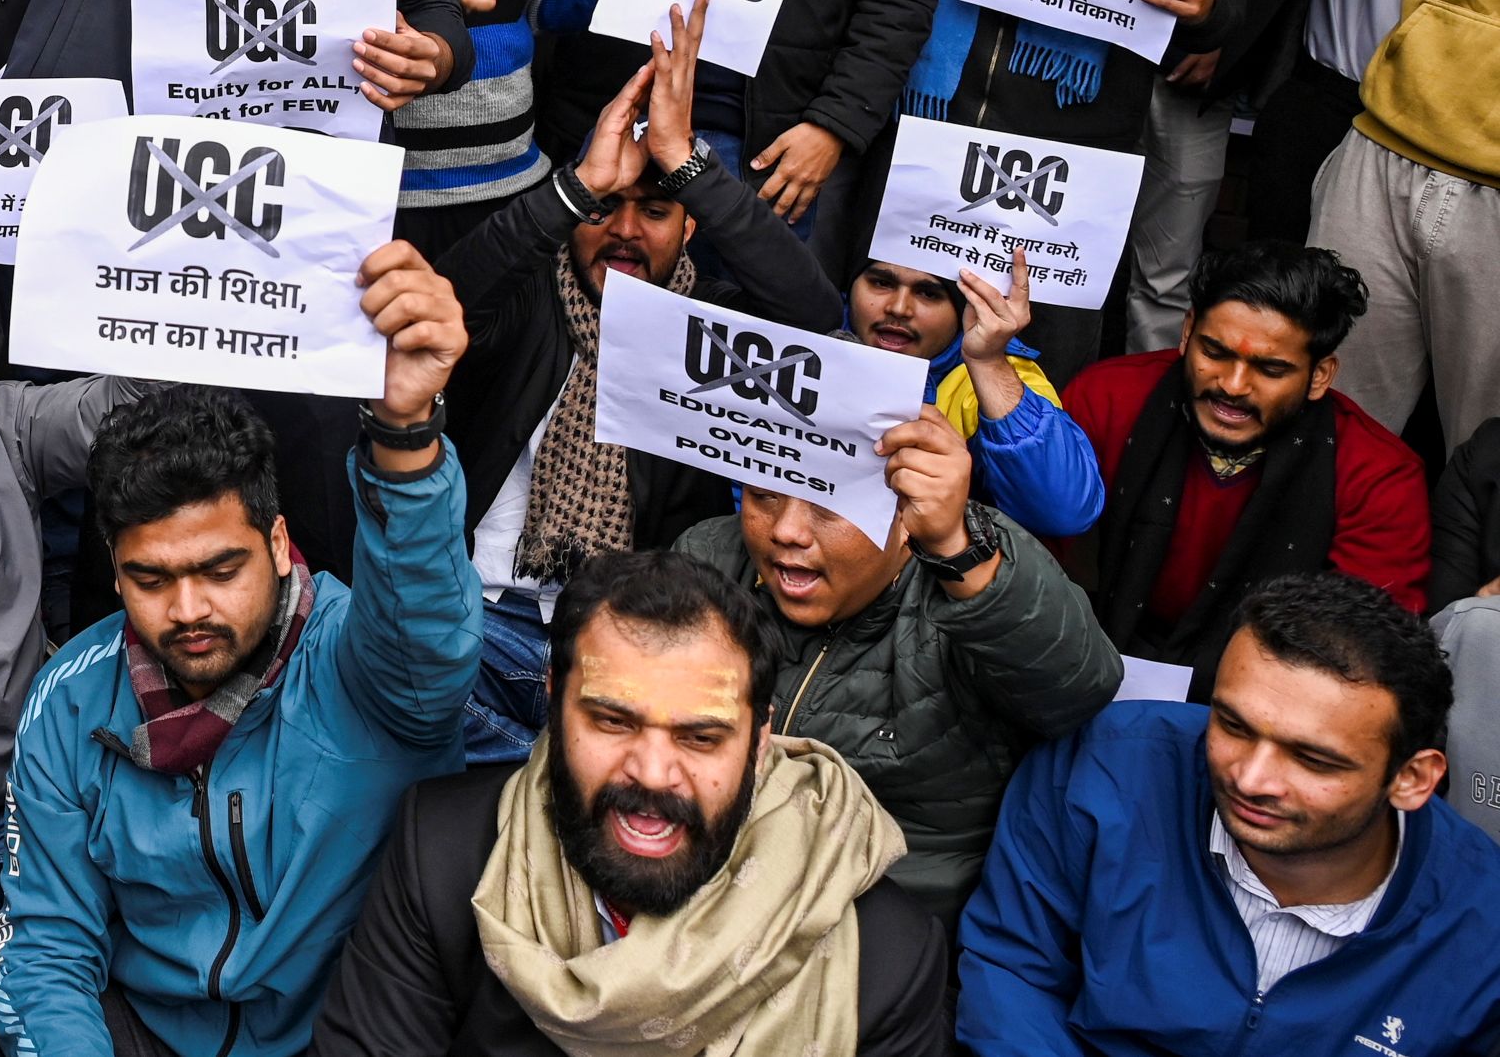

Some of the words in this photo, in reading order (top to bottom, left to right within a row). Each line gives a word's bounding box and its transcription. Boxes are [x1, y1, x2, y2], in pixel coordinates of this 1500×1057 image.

[168, 82, 249, 103] Equity
[257, 79, 294, 92] for
[302, 76, 361, 95] ALL,
[239, 102, 274, 118] for
[283, 99, 340, 114] FEW
[1, 194, 16, 212] में
[126, 136, 286, 242] UGC
[960, 141, 1069, 216] UGC
[910, 235, 962, 258] भविष्य
[966, 247, 981, 264] से
[1052, 269, 1087, 287] नहीं!
[930, 214, 982, 239] नियमों
[984, 226, 999, 244] में
[1046, 241, 1080, 261] करो,
[95, 264, 162, 294] आज
[168, 265, 212, 299] की
[219, 268, 307, 314] शिक्षा,
[97, 315, 159, 346] कल
[165, 322, 209, 351] का
[214, 327, 299, 360] भारत!
[685, 315, 822, 417] UGC
[660, 389, 857, 457] EDUCATION
[709, 427, 801, 462] OVER
[676, 436, 835, 496] POLITICS!
